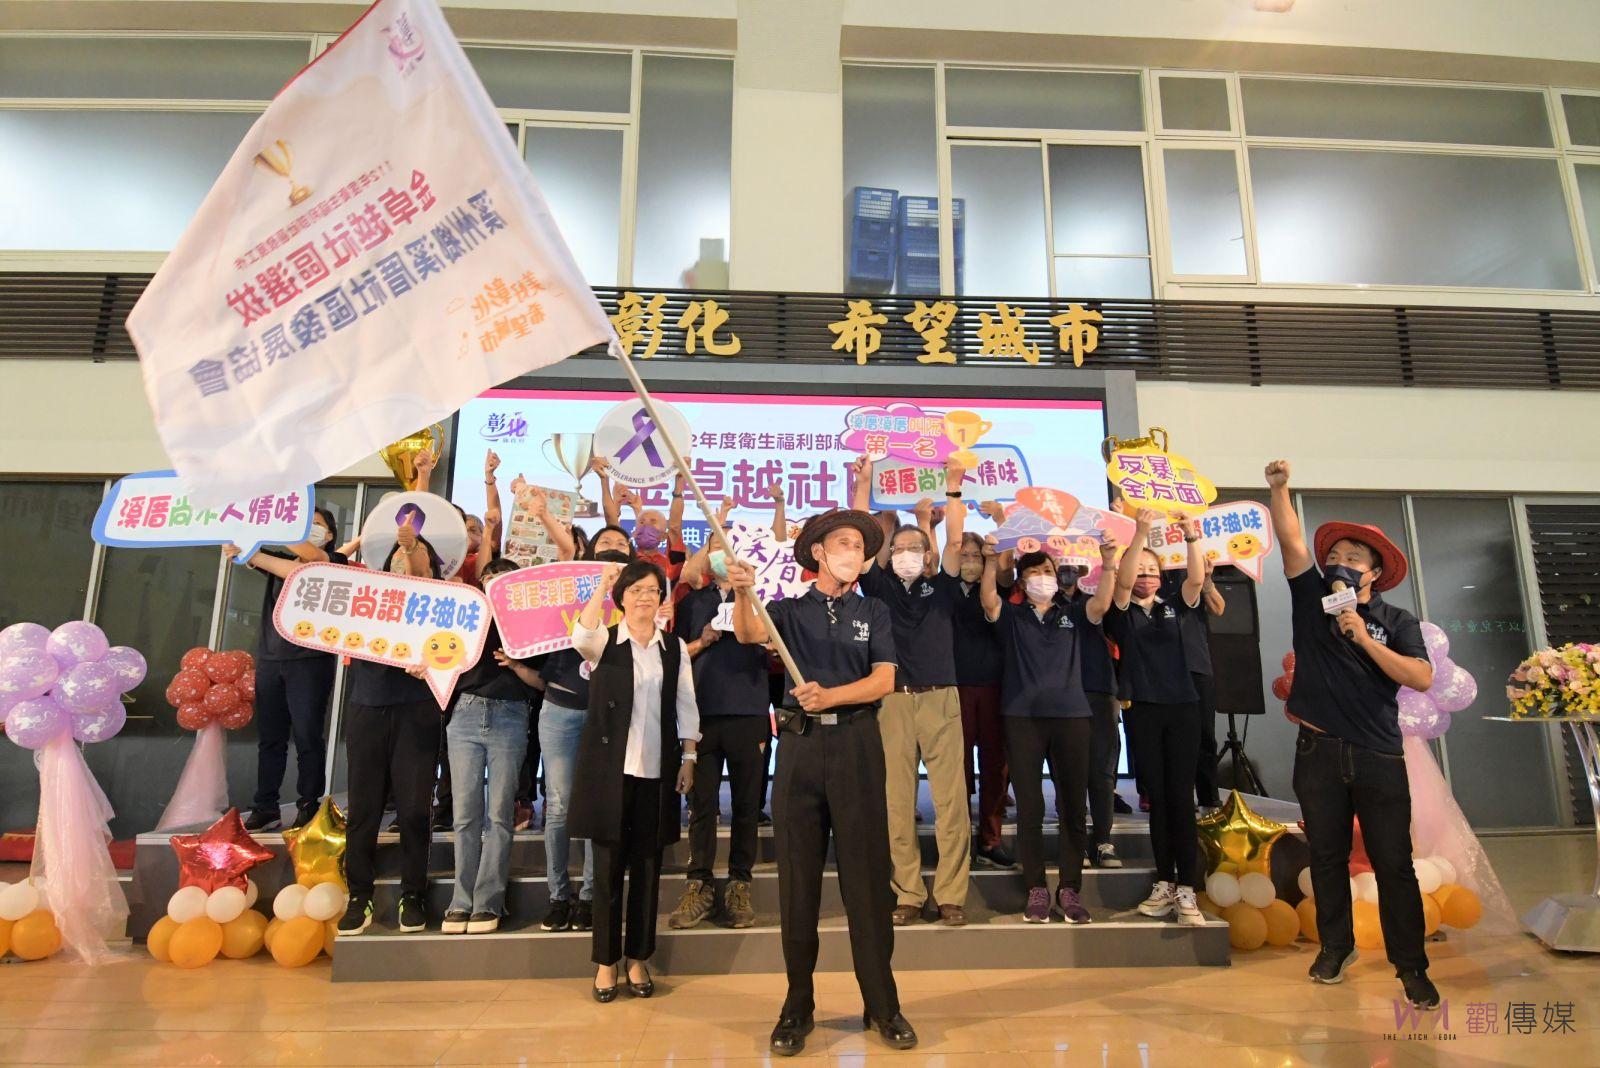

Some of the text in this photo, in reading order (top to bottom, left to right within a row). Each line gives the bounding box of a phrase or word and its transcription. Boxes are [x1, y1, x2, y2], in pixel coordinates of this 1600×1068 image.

[609, 291, 1103, 367] 彰化 希望城市
[865, 434, 937, 459] 第一名
[957, 428, 967, 442] 1
[1116, 453, 1174, 481] 反暴
[1119, 475, 1207, 506] 全方面
[294, 577, 480, 633] 溪厝尚讚好滋味
